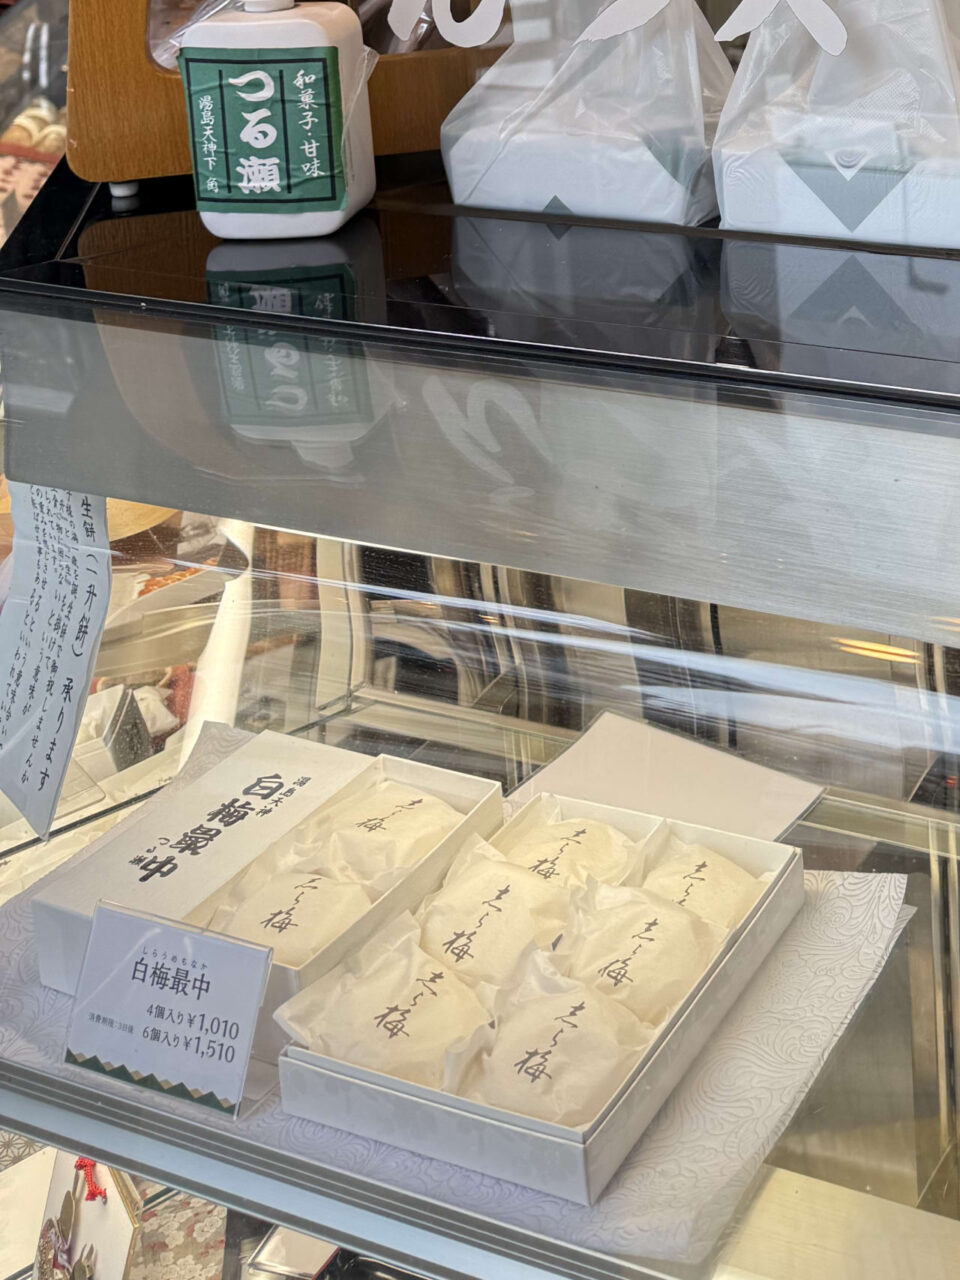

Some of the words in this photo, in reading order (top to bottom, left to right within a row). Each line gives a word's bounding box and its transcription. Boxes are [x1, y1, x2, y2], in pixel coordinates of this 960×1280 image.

[228, 70, 281, 194] つる瀬
[131, 957, 211, 1000] 白梅最中
[142, 946, 208, 971] しらうめもなか
